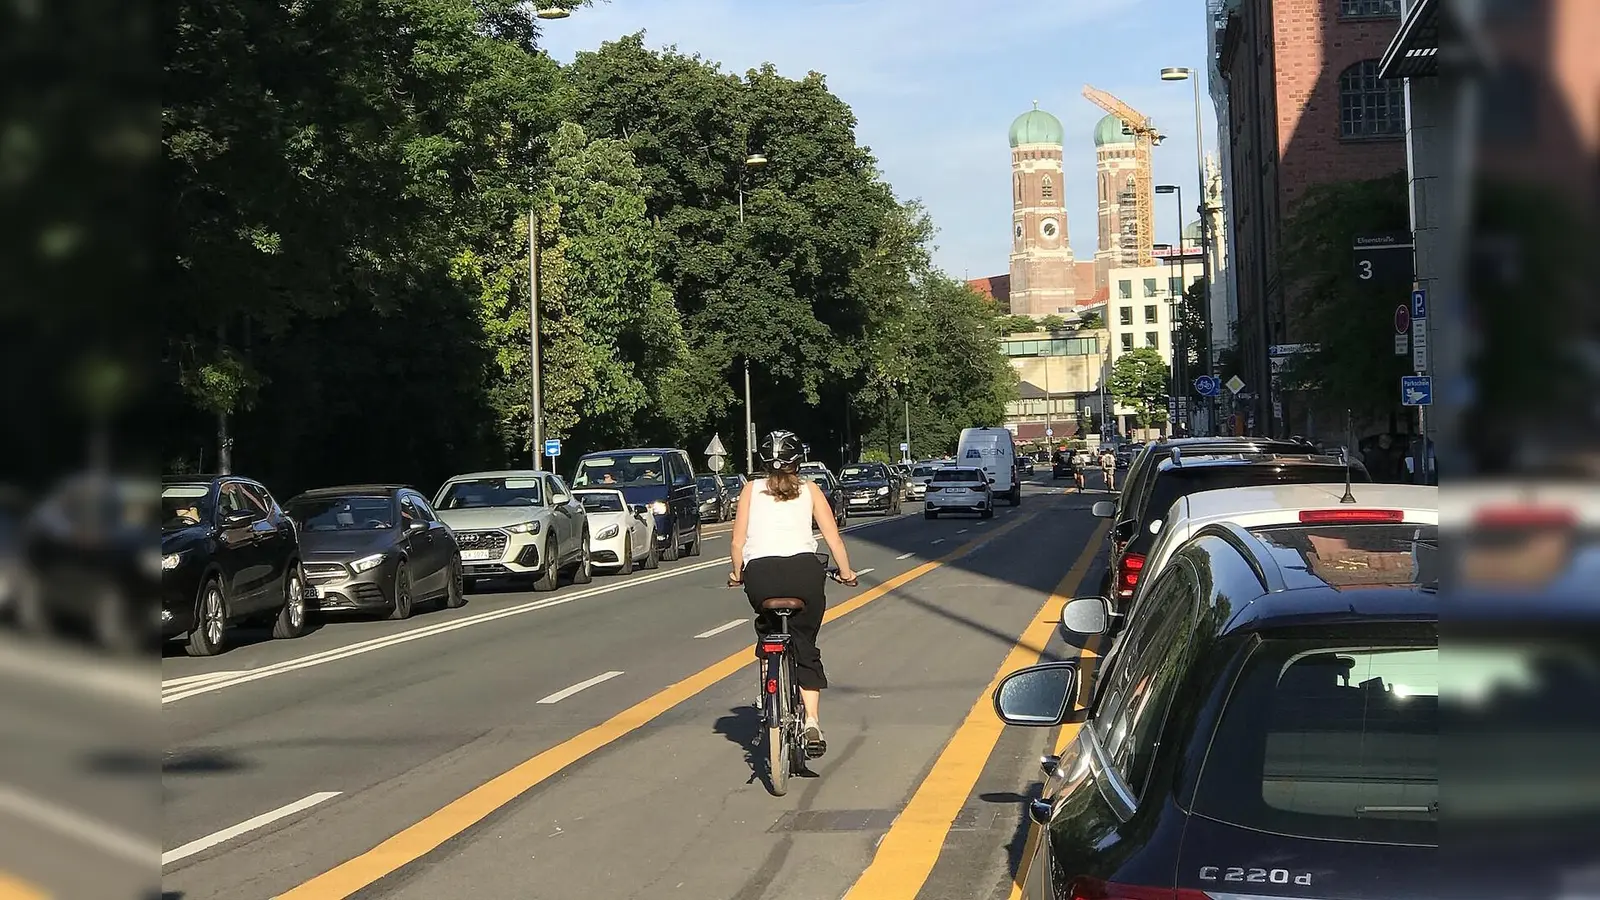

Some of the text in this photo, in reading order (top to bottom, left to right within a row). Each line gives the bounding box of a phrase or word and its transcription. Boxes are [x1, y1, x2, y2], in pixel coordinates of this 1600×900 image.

[1359, 260, 1373, 280] 3
[1199, 866, 1312, 886] C 220 d
